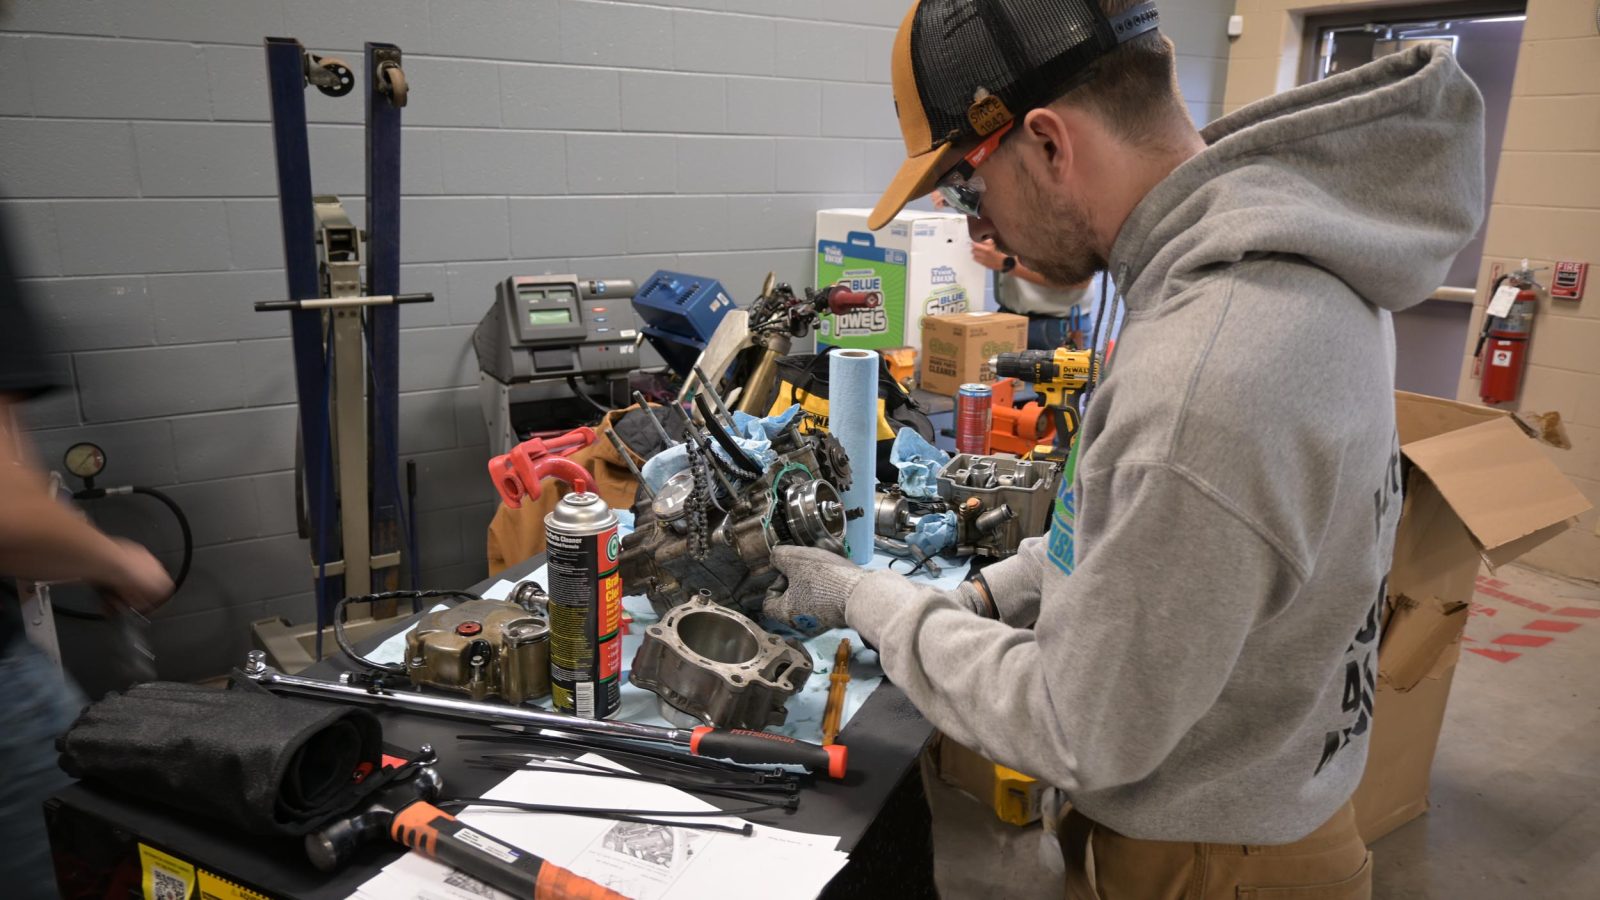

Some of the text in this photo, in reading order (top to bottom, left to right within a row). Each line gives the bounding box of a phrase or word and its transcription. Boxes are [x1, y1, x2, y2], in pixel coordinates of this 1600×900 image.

[970, 100, 1001, 123] SINCE
[1557, 262, 1580, 271] FIRE
[853, 279, 880, 290] BLUE
[940, 291, 964, 305] BLUE
[928, 364, 957, 378] CLEANER
[560, 535, 583, 544] Cleaner
